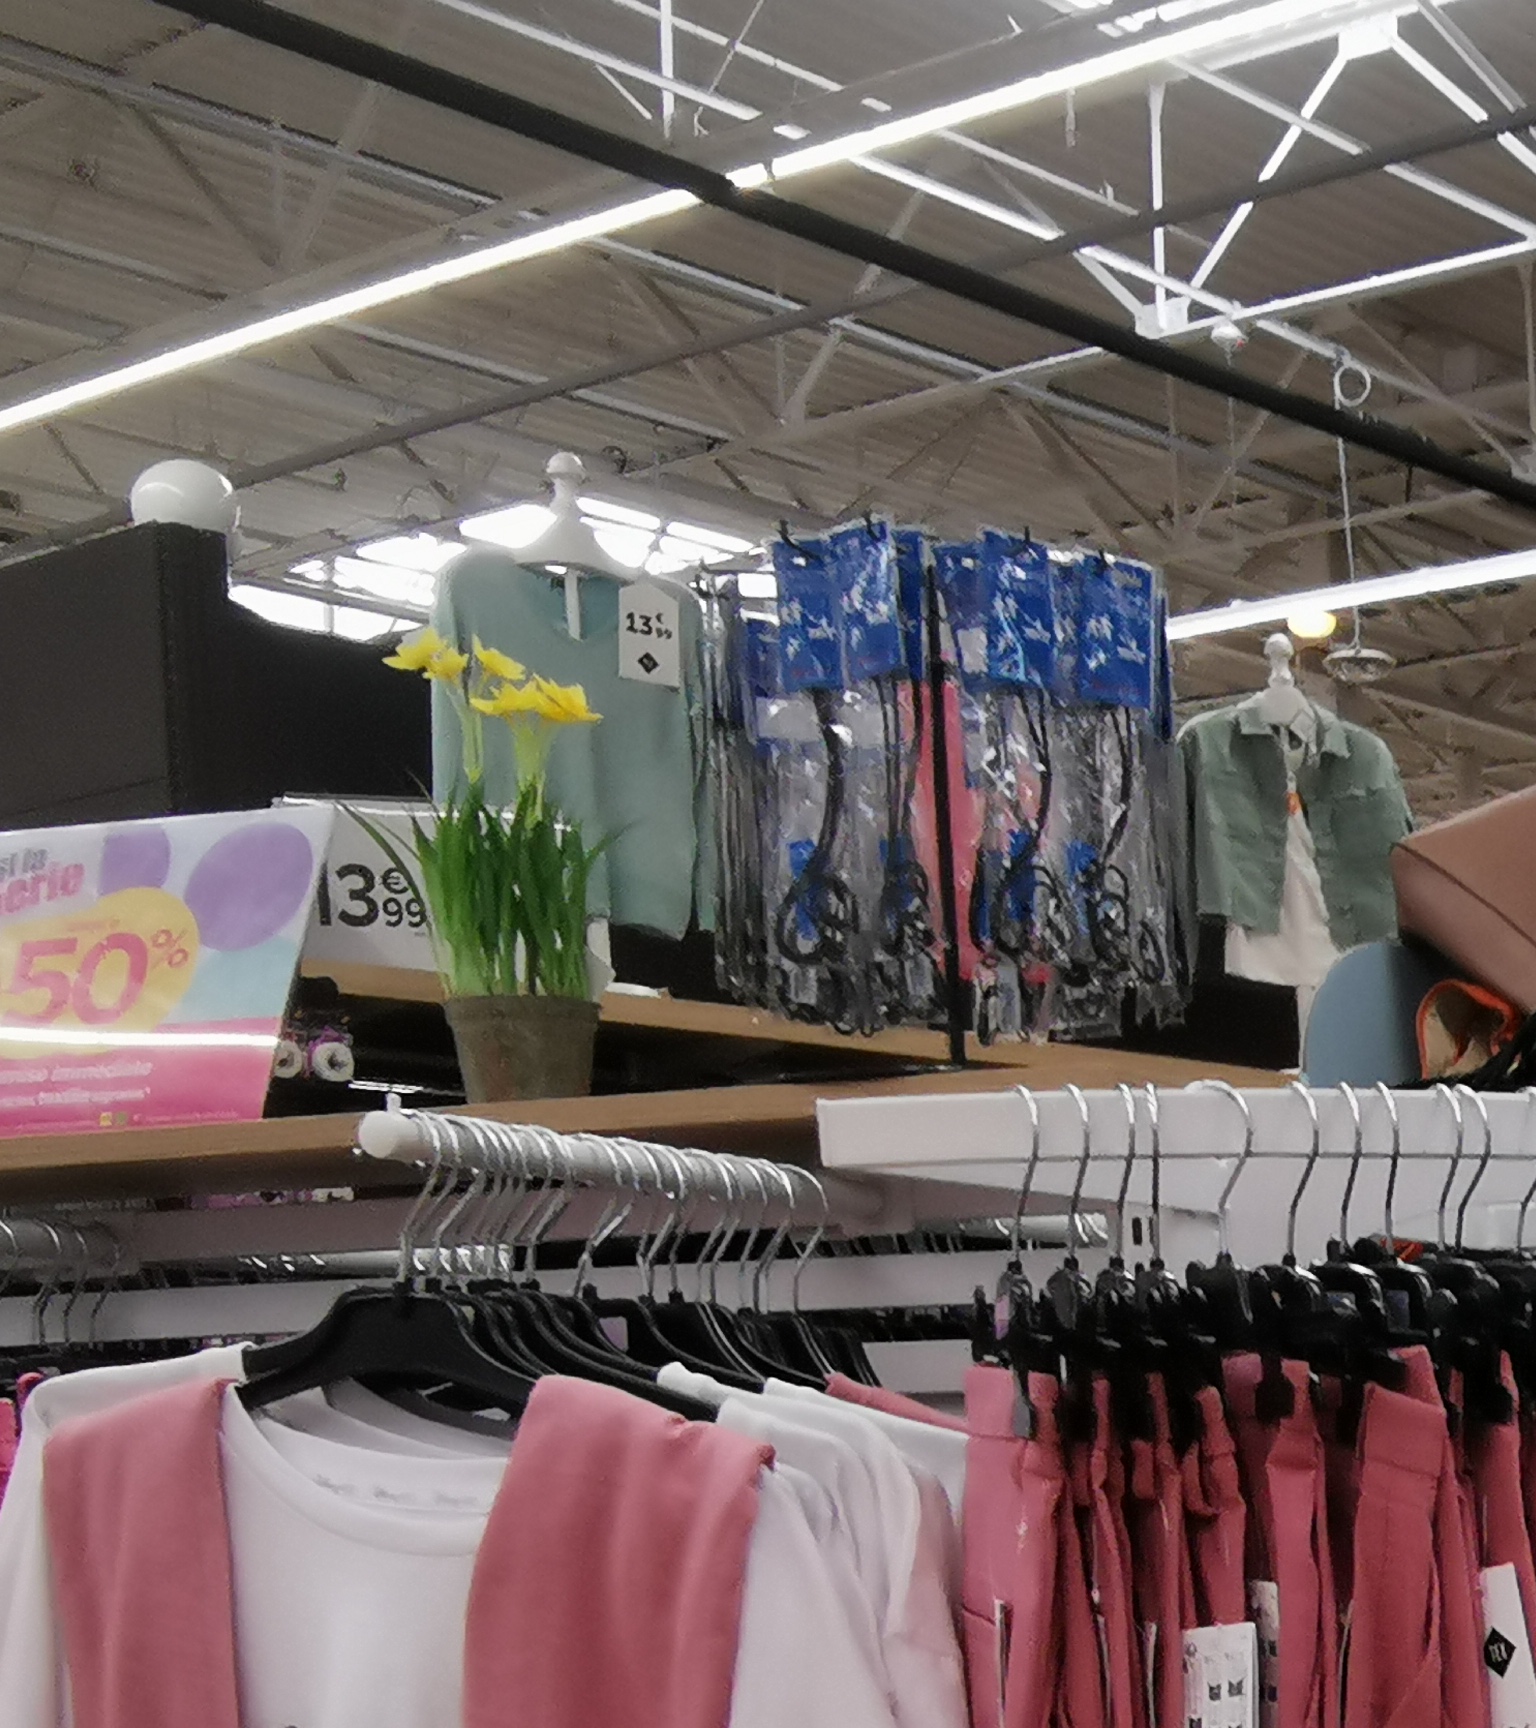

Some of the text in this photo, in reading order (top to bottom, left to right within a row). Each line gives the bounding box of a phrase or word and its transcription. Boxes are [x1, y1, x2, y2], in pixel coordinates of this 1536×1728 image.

[0, 863, 85, 914] erie
[317, 861, 379, 927] 13
[382, 897, 427, 928] 99
